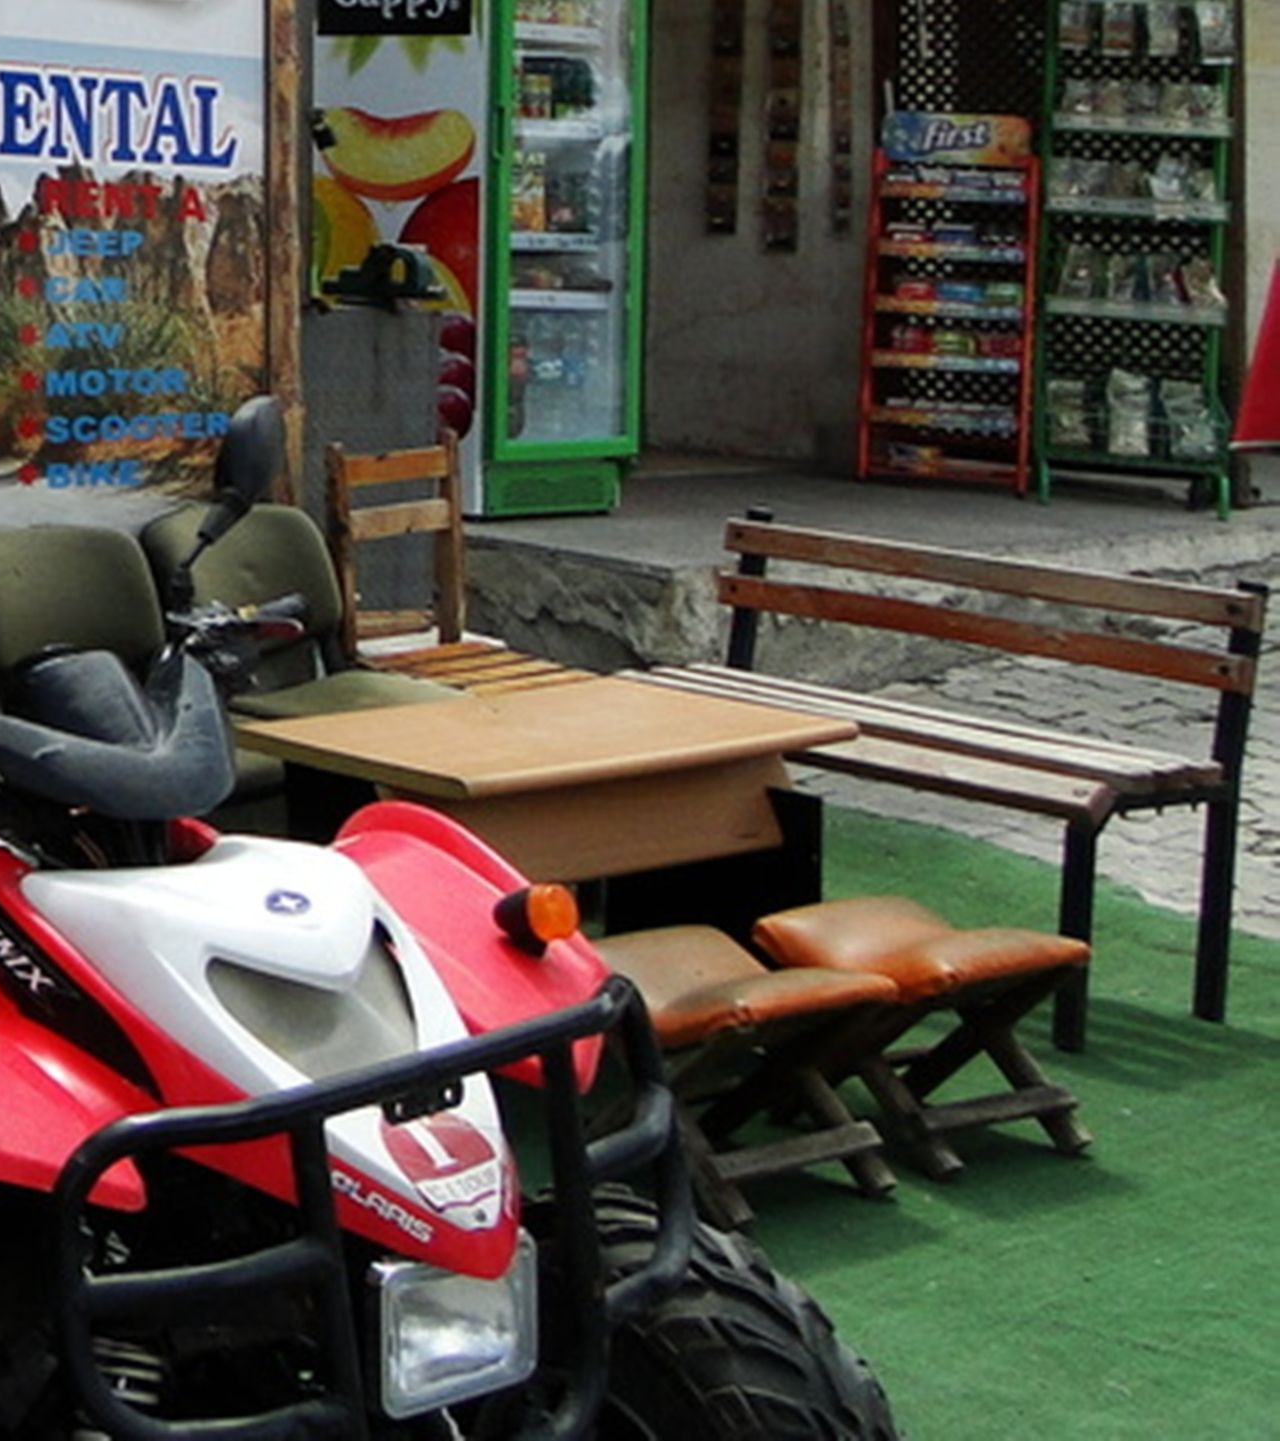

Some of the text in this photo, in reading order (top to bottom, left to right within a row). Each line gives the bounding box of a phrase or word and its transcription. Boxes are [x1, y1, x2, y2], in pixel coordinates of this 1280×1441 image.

[40, 178, 207, 223] RENT A
[44, 229, 144, 257] JEEP
[44, 276, 128, 303] CAR
[44, 323, 125, 349] ATV
[44, 367, 188, 397] MOTOR
[44, 412, 232, 444] SCOOTER
[46, 460, 142, 489] BIKE
